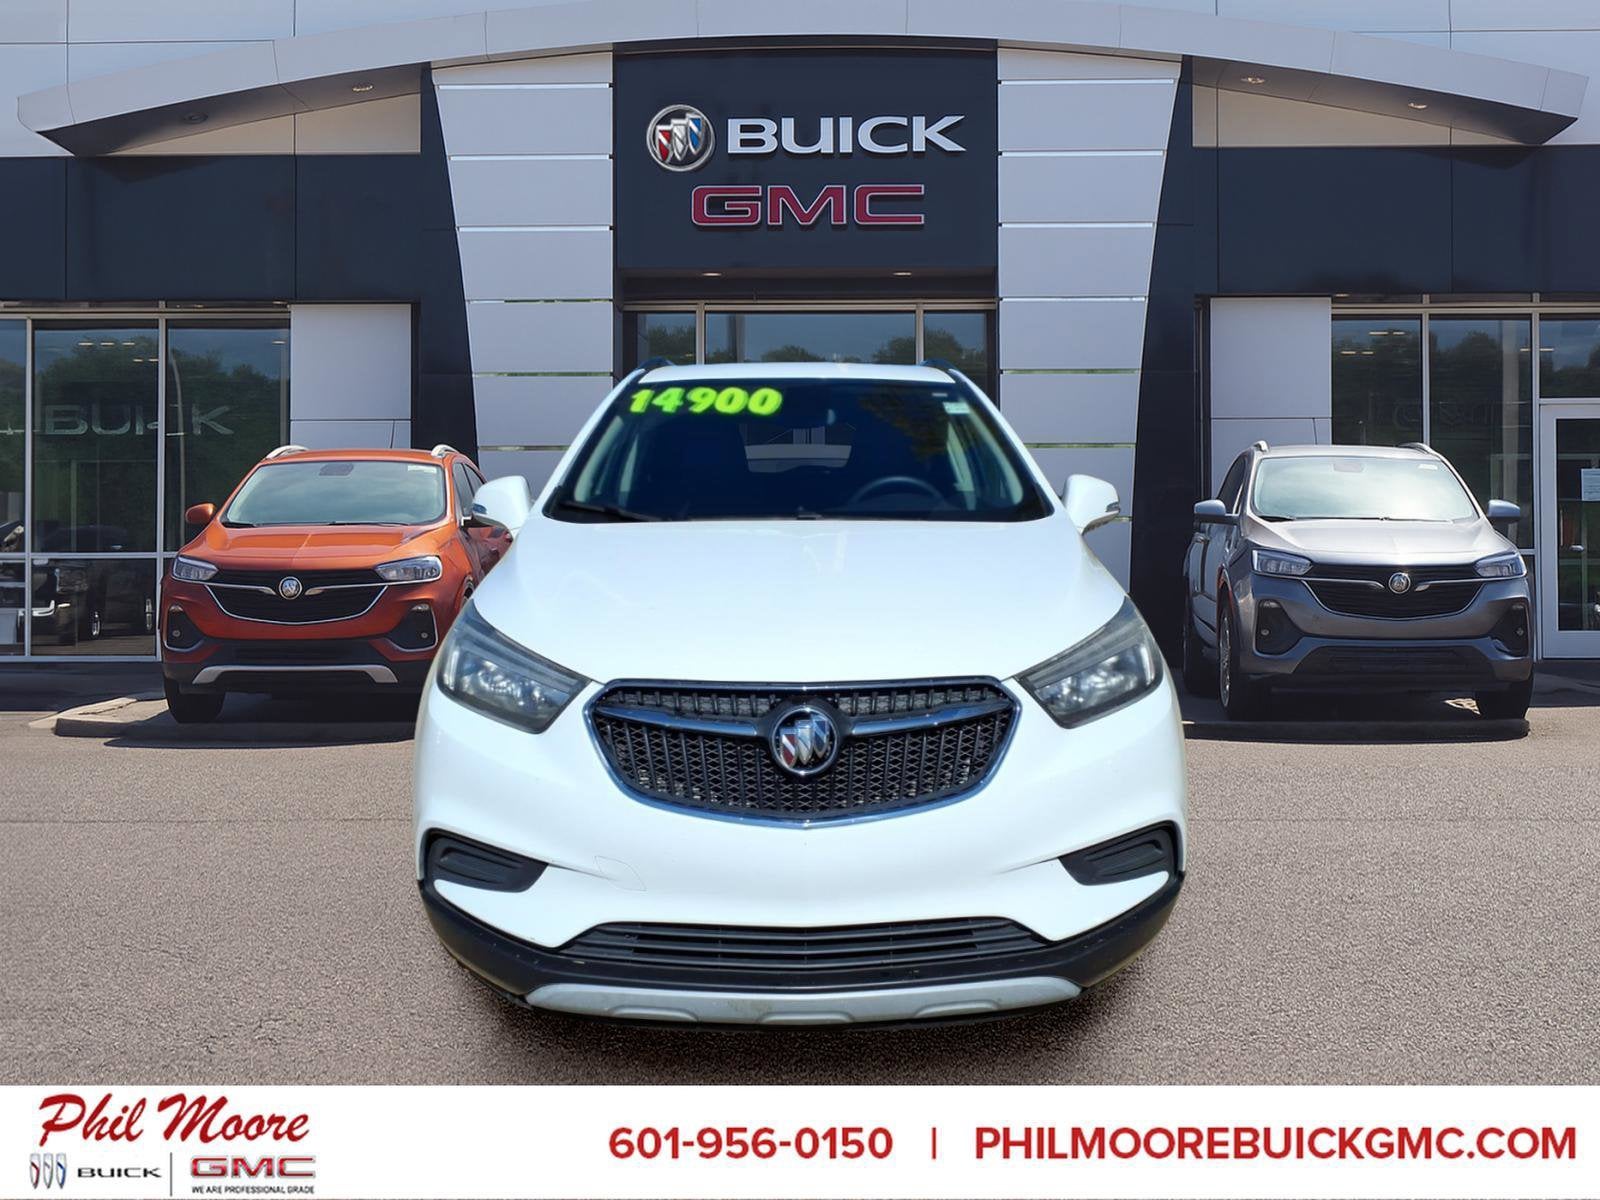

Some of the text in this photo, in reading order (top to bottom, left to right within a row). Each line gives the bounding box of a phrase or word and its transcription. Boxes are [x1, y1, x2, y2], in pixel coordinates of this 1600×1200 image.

[727, 115, 967, 154] BUICK
[691, 184, 925, 226] GMC
[629, 386, 783, 416] 14900
[45, 404, 234, 436] BUIK
